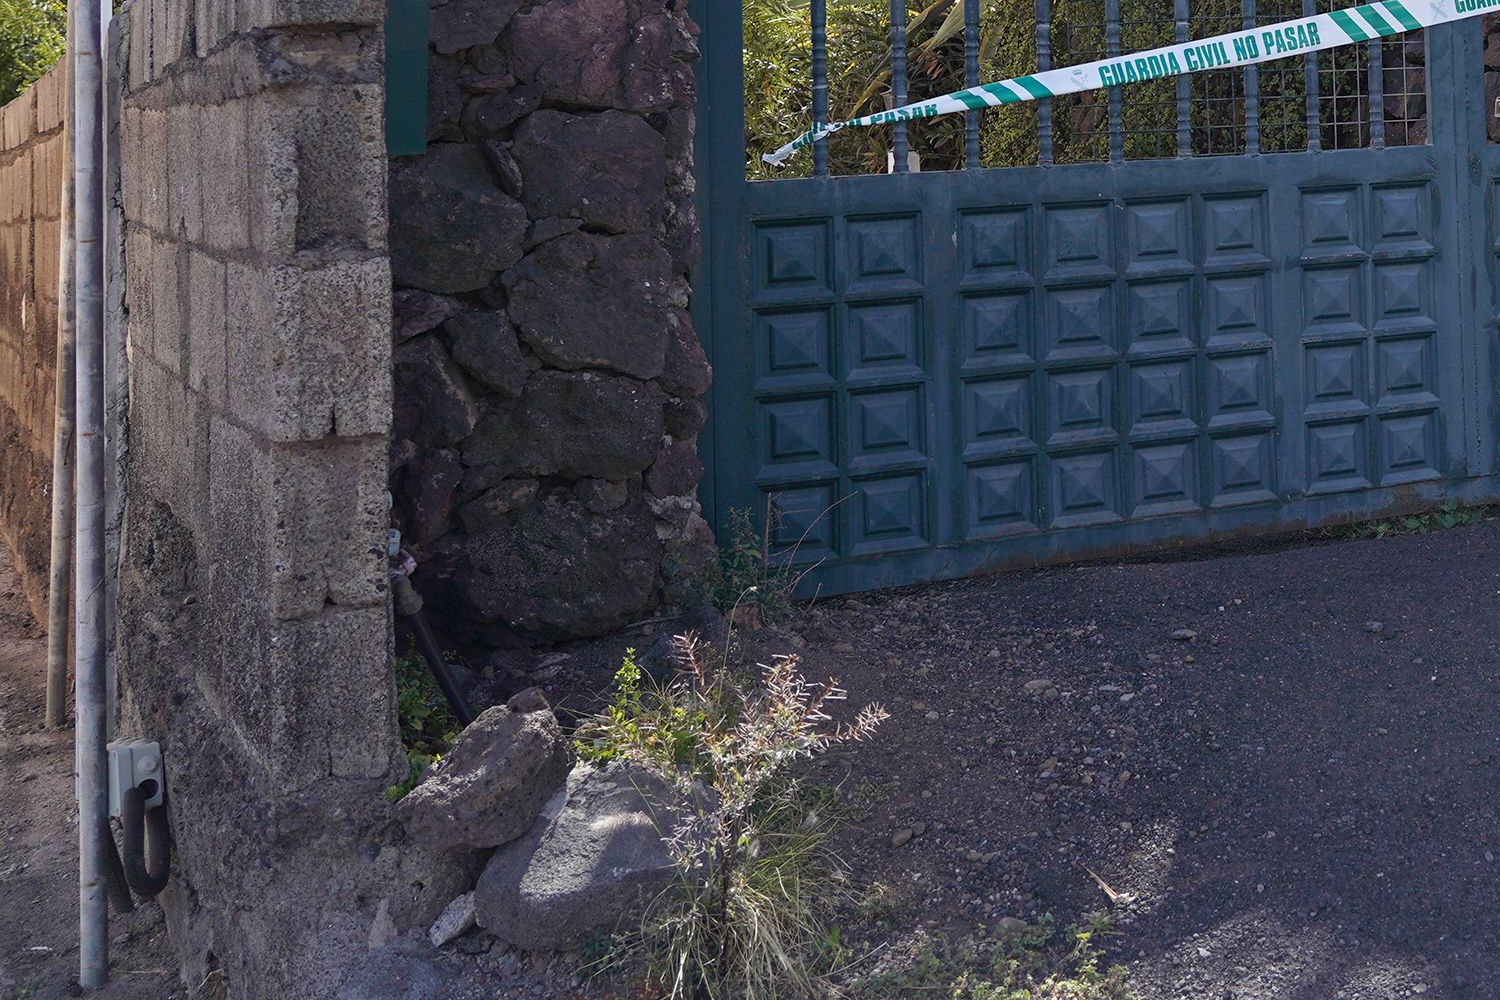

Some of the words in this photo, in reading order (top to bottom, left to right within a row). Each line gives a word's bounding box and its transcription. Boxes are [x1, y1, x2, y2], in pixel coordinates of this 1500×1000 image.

[1098, 52, 1181, 88] GUARDIA
[1183, 41, 1231, 72] CIVIL
[1232, 35, 1260, 61] NO
[1263, 22, 1321, 55] PASAR
